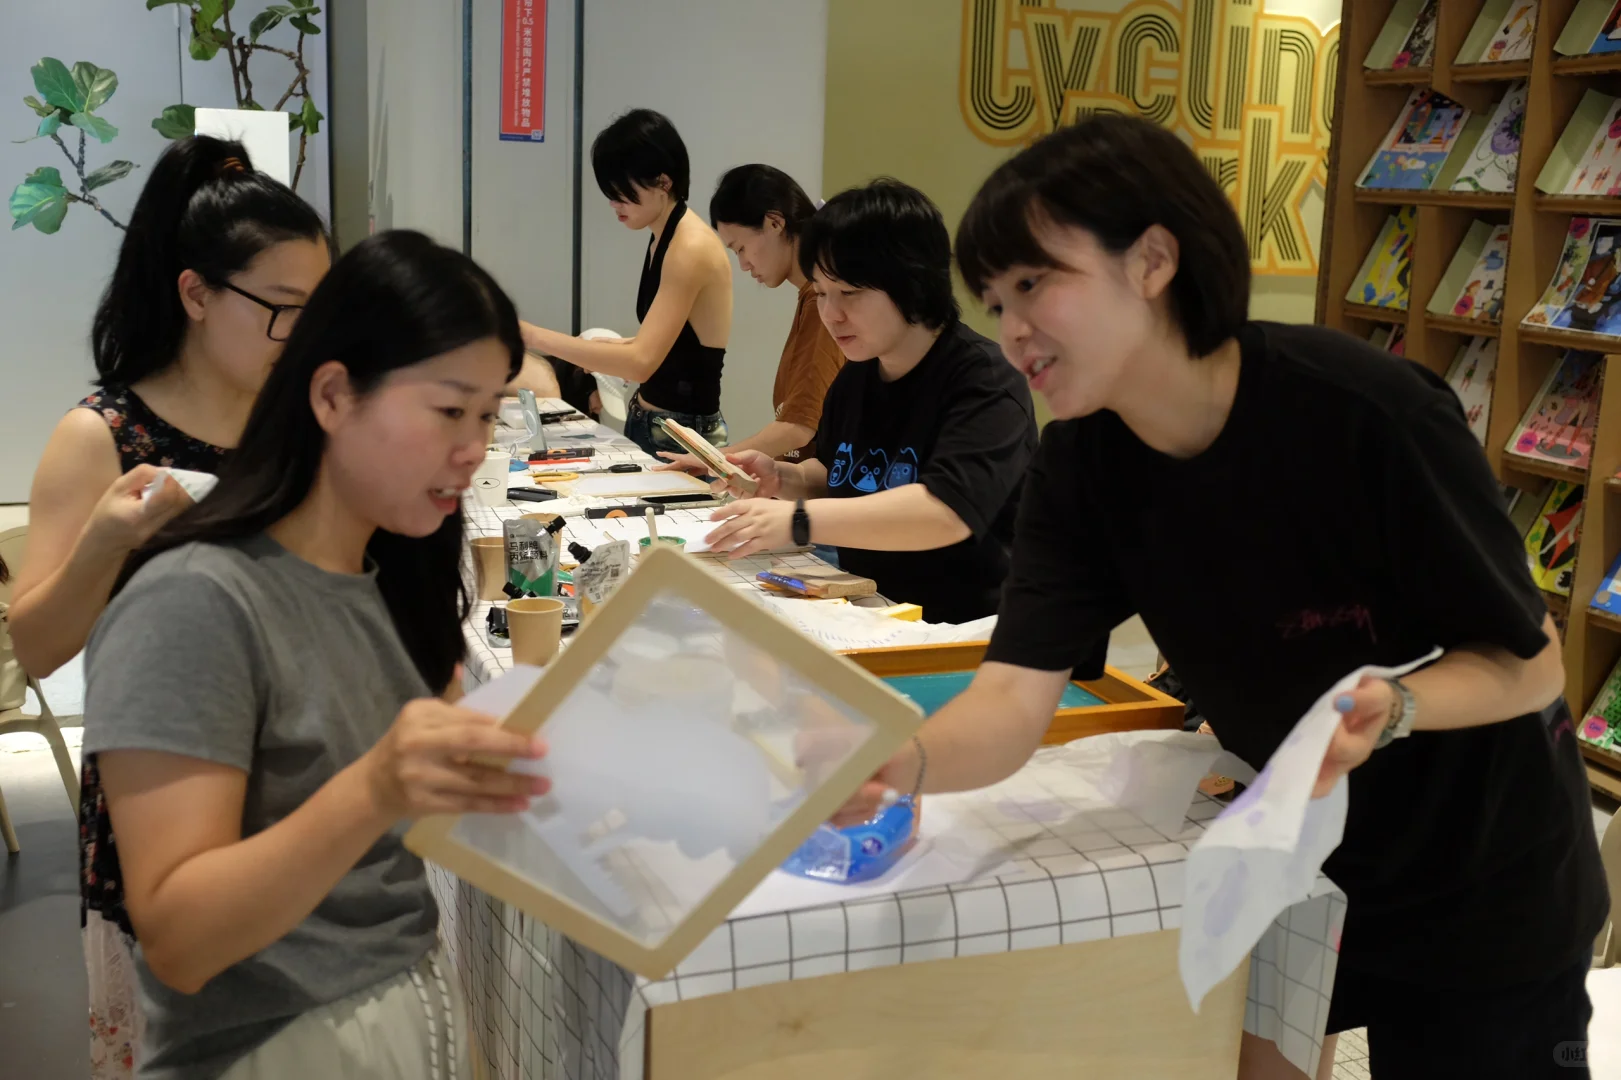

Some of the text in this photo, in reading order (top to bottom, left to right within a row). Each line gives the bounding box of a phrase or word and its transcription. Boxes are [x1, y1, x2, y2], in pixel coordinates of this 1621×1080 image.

[509, 541, 538, 552] 马利牌
[509, 550, 548, 561] 丙烯颜料
